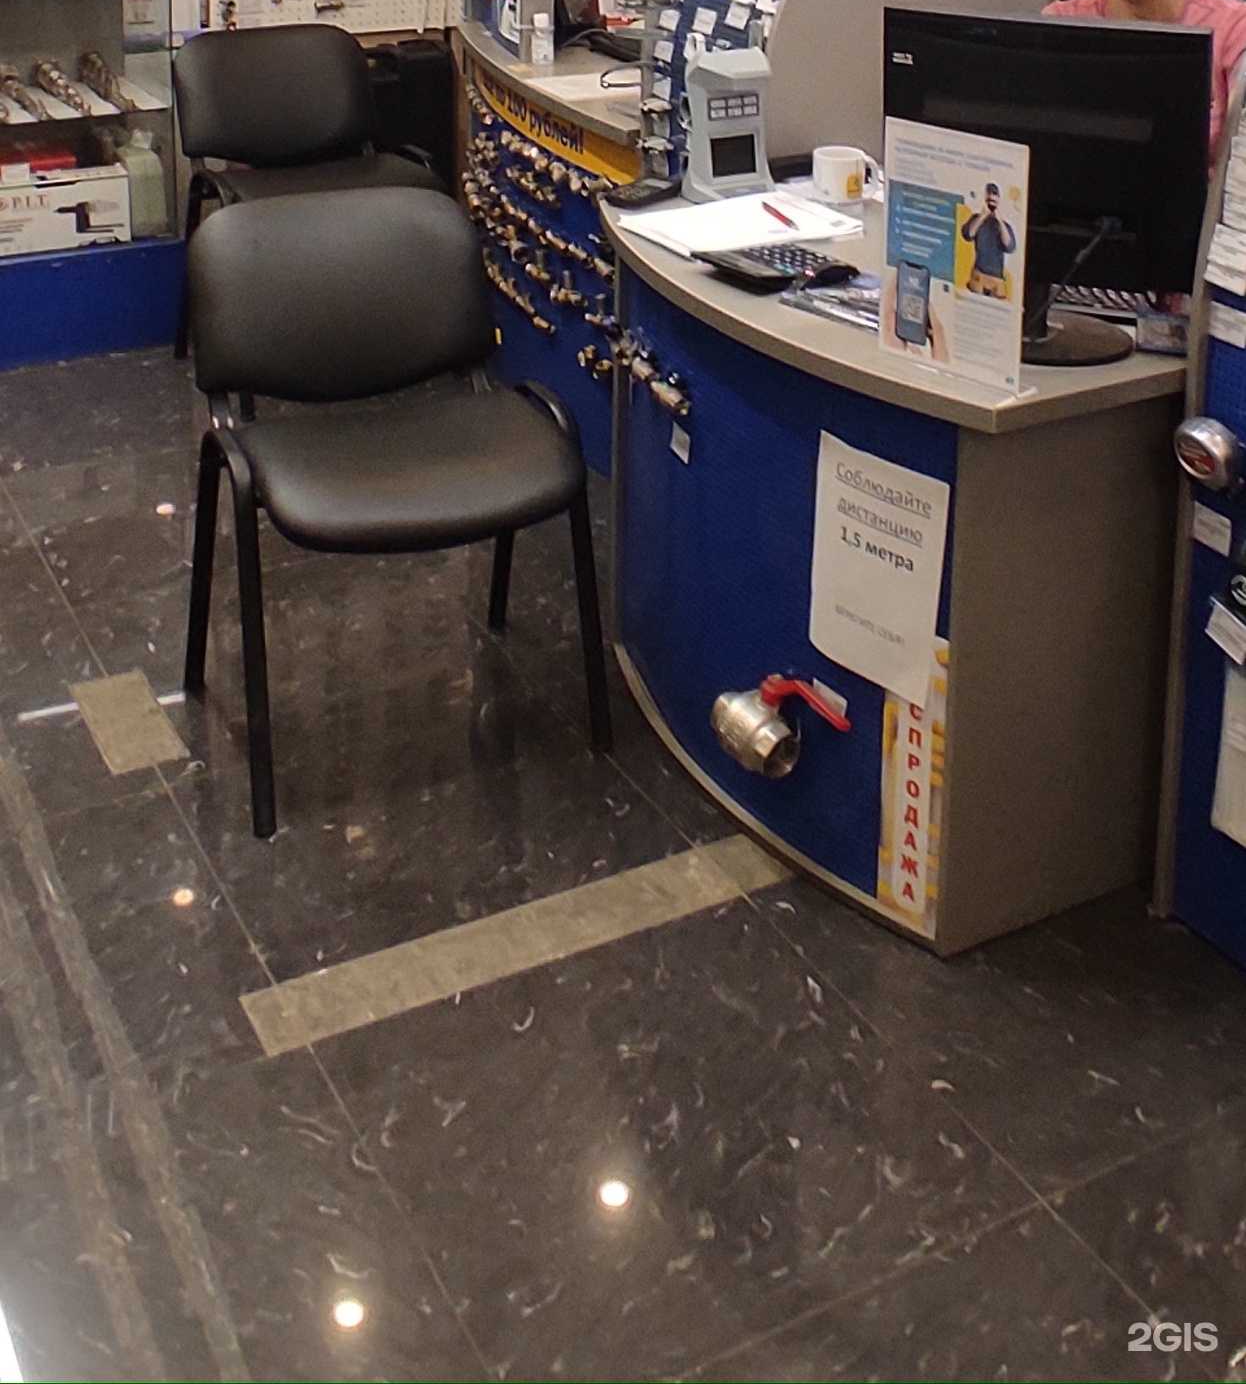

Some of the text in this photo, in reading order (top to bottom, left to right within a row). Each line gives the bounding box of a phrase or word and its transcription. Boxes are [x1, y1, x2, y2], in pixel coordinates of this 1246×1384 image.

[529, 112, 584, 154] рублей!
[836, 463, 932, 517] Соблюдайте
[838, 498, 923, 546] дистанцию
[841, 526, 914, 572] 1,5 метра
